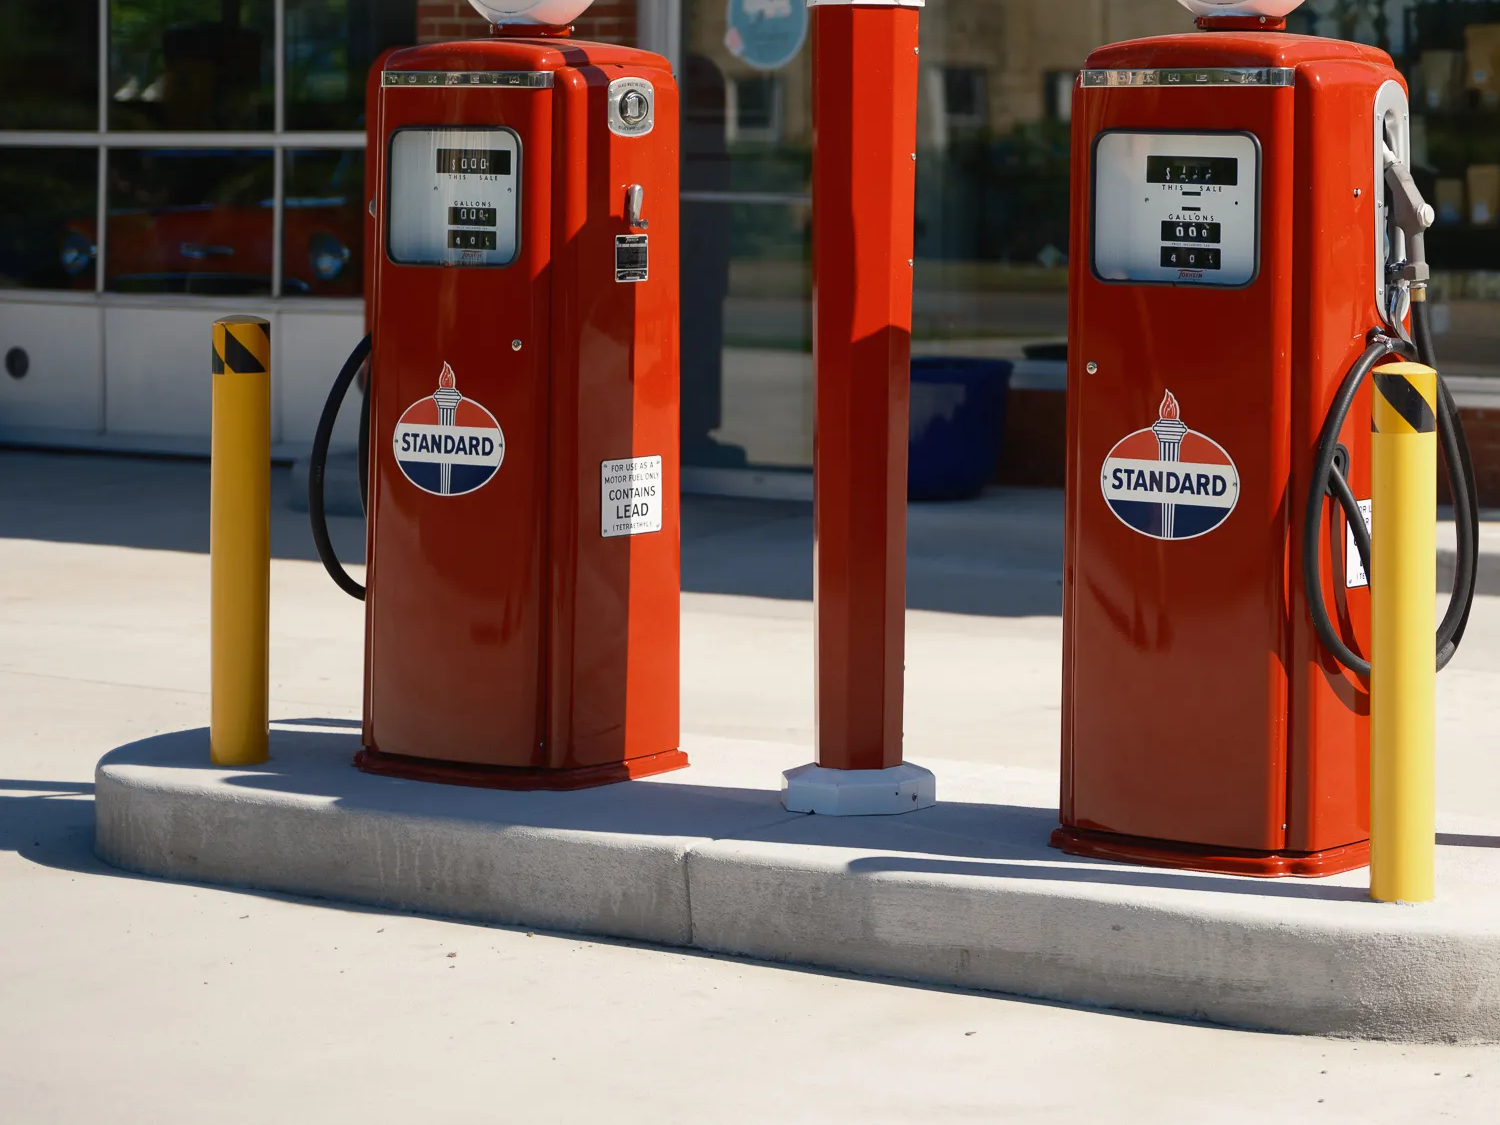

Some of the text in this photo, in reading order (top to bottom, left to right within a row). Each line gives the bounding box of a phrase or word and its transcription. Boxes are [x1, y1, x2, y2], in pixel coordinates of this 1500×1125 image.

[1168, 214, 1215, 222] GALLONS
[401, 432, 495, 456] STANDARD
[611, 464, 624, 472] FOR
[626, 463, 638, 471] USE
[640, 461, 648, 469] AS
[604, 472, 660, 484] MOTOR FUEL ONLY
[1111, 467, 1227, 497] STANDARD
[608, 485, 656, 501] CONTAINS
[616, 502, 649, 519] LEAD
